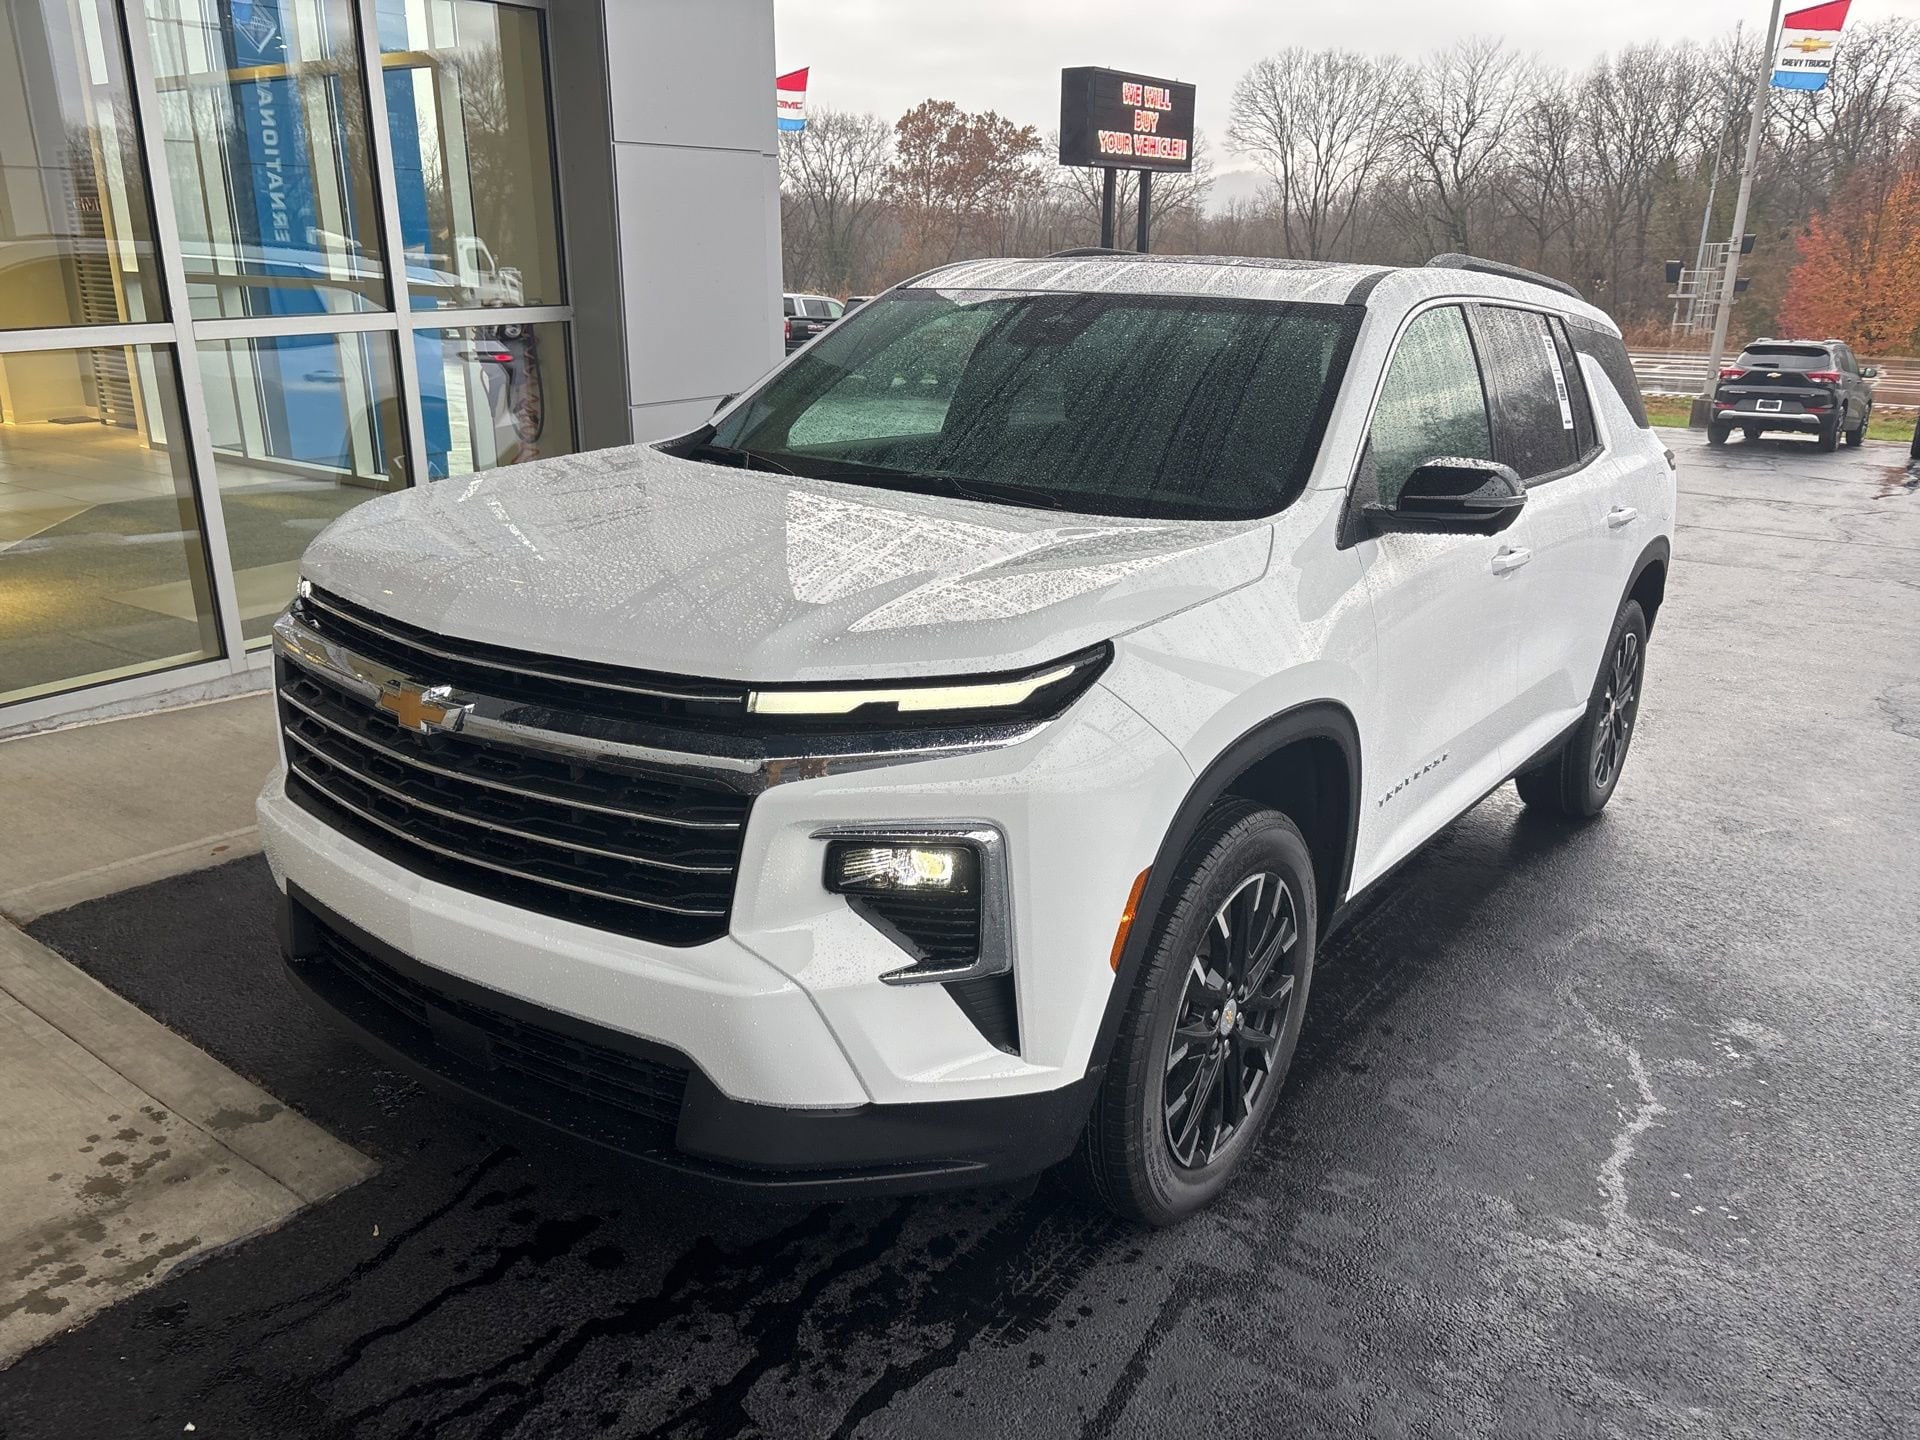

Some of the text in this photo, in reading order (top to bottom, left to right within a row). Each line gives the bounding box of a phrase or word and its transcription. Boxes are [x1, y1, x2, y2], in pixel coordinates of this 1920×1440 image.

[1782, 58, 1831, 67] CHEVY TRUCKS
[776, 100, 802, 109] GMC
[1123, 82, 1171, 111] WE WILL
[1134, 109, 1159, 133] BUY
[1098, 129, 1132, 154] YOUR
